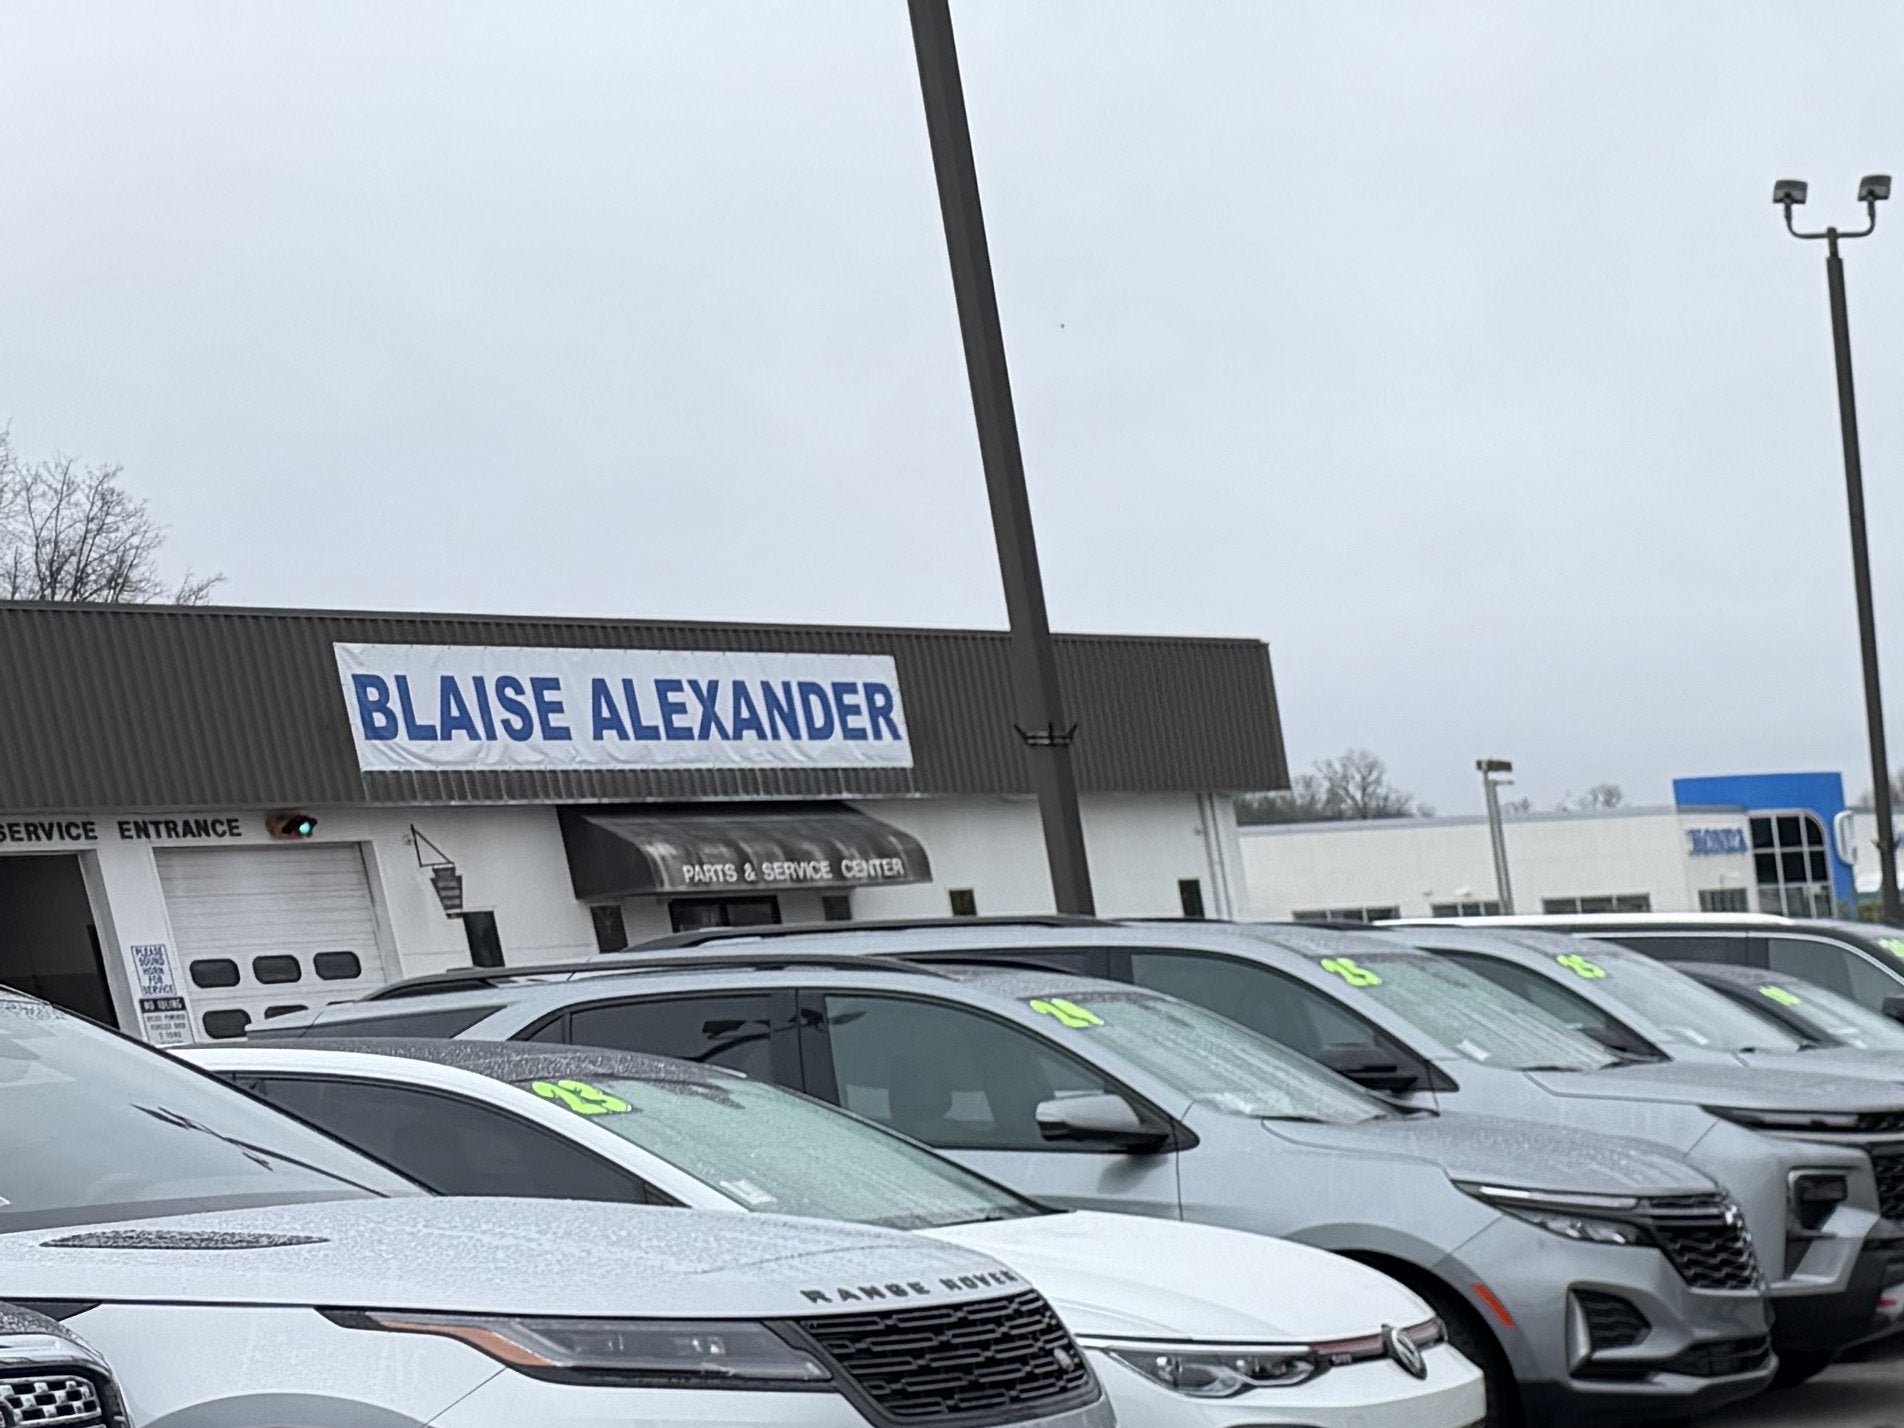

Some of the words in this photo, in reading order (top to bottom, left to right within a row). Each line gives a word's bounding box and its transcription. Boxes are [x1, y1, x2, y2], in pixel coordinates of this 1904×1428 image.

[351, 673, 572, 741] BLAISE
[591, 677, 902, 741] ALEXANDER
[117, 818, 242, 839] ENTRANCE
[683, 864, 737, 883] PARTS
[744, 862, 757, 881] &
[762, 861, 832, 880] SERVICE
[841, 858, 904, 878] CENTER
[799, 1281, 931, 1304] RANGE
[939, 1269, 1018, 1292] ROVER
